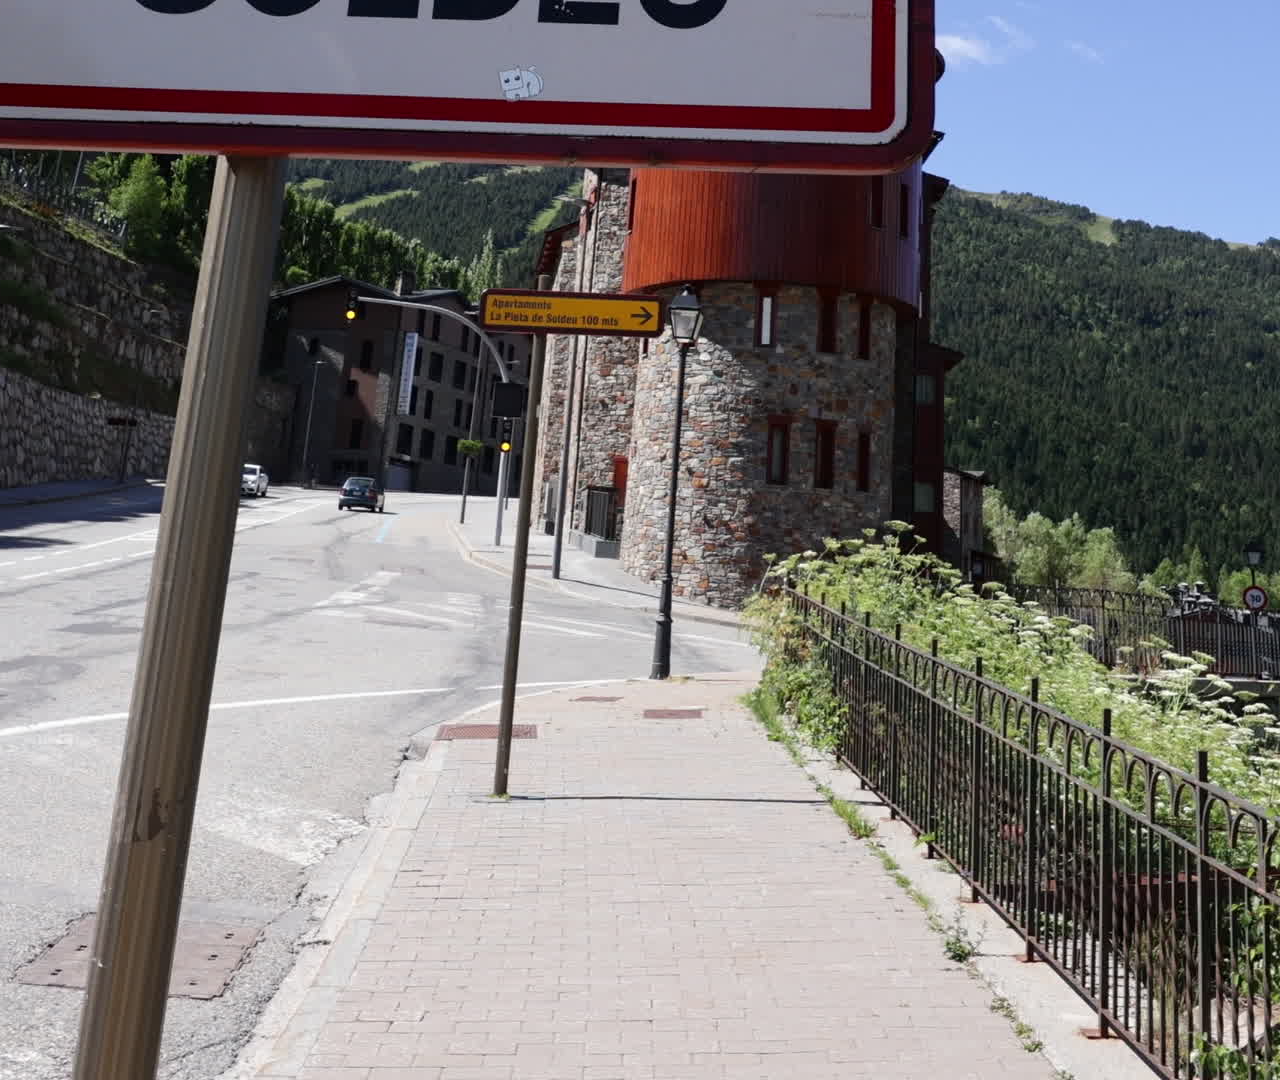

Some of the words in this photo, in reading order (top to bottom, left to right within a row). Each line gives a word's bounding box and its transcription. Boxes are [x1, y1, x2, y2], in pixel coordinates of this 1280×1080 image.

[490, 311, 502, 321] La
[531, 313, 544, 323] de
[546, 312, 578, 324] Soldeu
[581, 315, 599, 326] 100
[601, 317, 619, 327] mts
